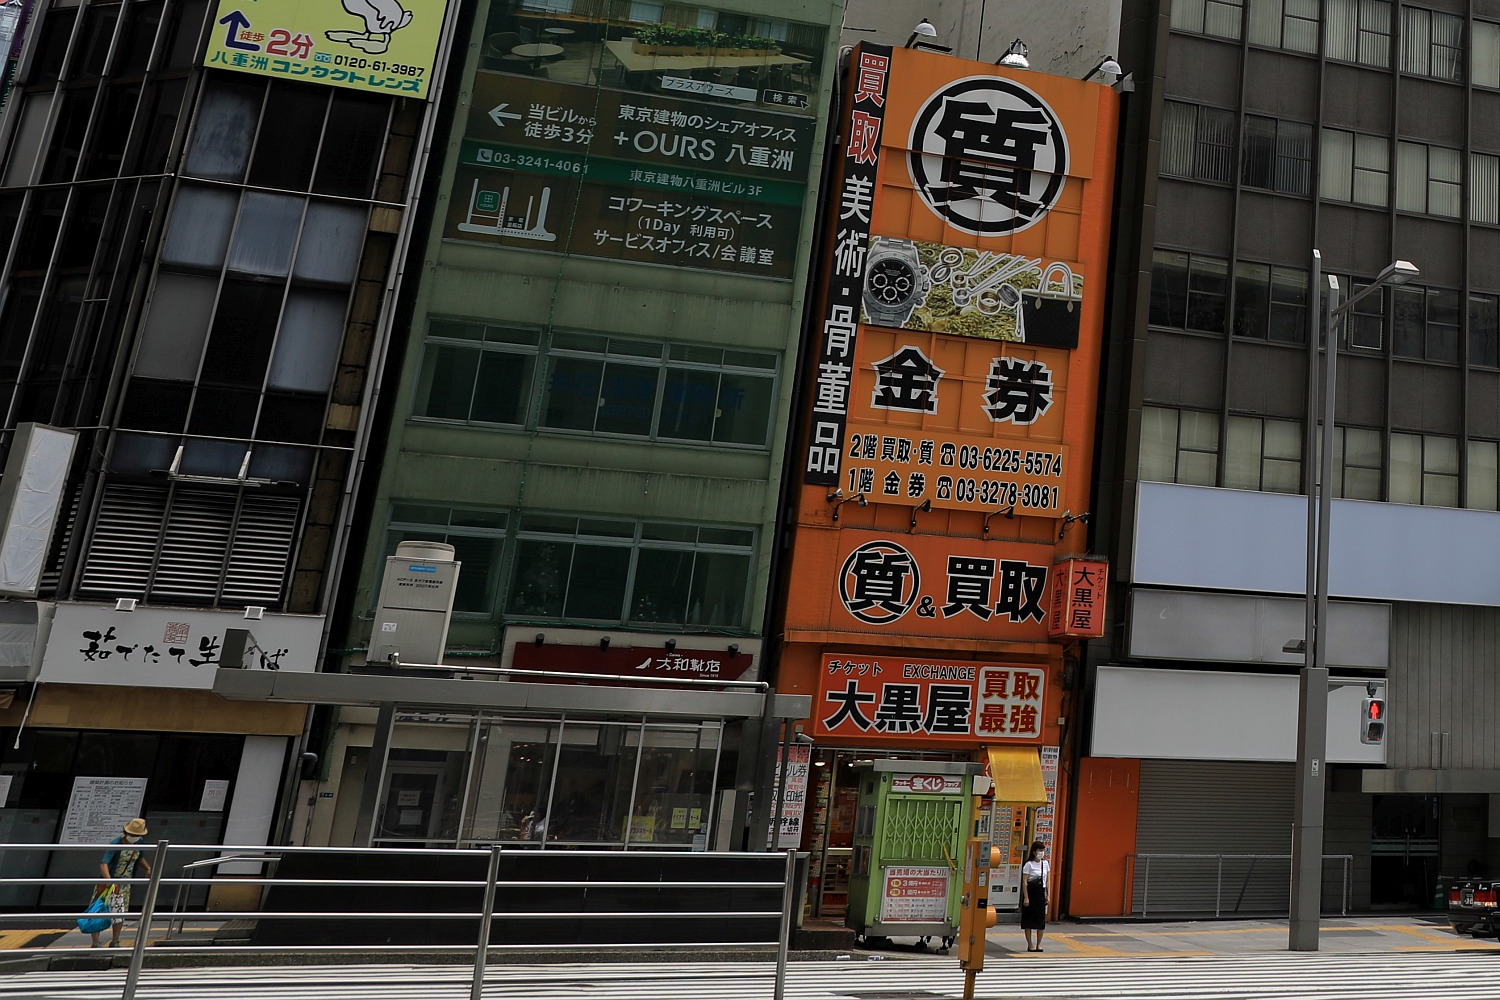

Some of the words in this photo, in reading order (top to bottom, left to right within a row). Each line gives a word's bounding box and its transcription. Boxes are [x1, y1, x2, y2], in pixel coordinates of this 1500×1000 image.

[239, 30, 265, 43] 徒歩
[266, 29, 314, 59] 2分
[210, 50, 269, 71] 八重洲
[271, 59, 423, 94] コンタクトレンズ
[333, 54, 425, 78] 0120-61-3987
[665, 77, 735, 97] プラスアワーズ
[772, 91, 799, 105] 検索
[527, 103, 597, 127] 当ビルから
[617, 103, 797, 143] 東京建物のシェアオフィス
[846, 52, 890, 167] 買取
[523, 120, 594, 145] 徒歩3分
[493, 151, 589, 175] 03-3241-4061
[725, 143, 795, 172] 八重洲
[922, 95, 1053, 222] 質
[629, 169, 745, 195] 東京建物八重洲ビル
[747, 184, 763, 196] 3F
[608, 196, 773, 230] コワーキングスペース
[638, 217, 681, 234] (1Day
[689, 223, 736, 242] 利用可)
[593, 229, 775, 266] サービスオフィス/会議室
[807, 174, 873, 475] 美術・骨董品
[870, 344, 1054, 427] 金券
[849, 433, 878, 460] 2階
[880, 435, 935, 466] 買取・質
[958, 447, 1063, 478] 03-6225-5574
[848, 467, 874, 494] 1階
[883, 470, 926, 498] 金券
[955, 477, 1059, 510] 03-3278-3081
[846, 549, 913, 616] 質
[915, 595, 937, 620] &
[940, 554, 1049, 625] 買取
[1068, 566, 1097, 630] 大黒屋
[655, 657, 721, 674] 大和靴店
[827, 659, 883, 678] チケット
[903, 663, 976, 681] EXCHANGE
[981, 669, 1040, 701] 買取
[823, 679, 973, 735] 大黒屋
[979, 703, 1038, 735] 最強
[912, 777, 942, 790] 宝くじ
